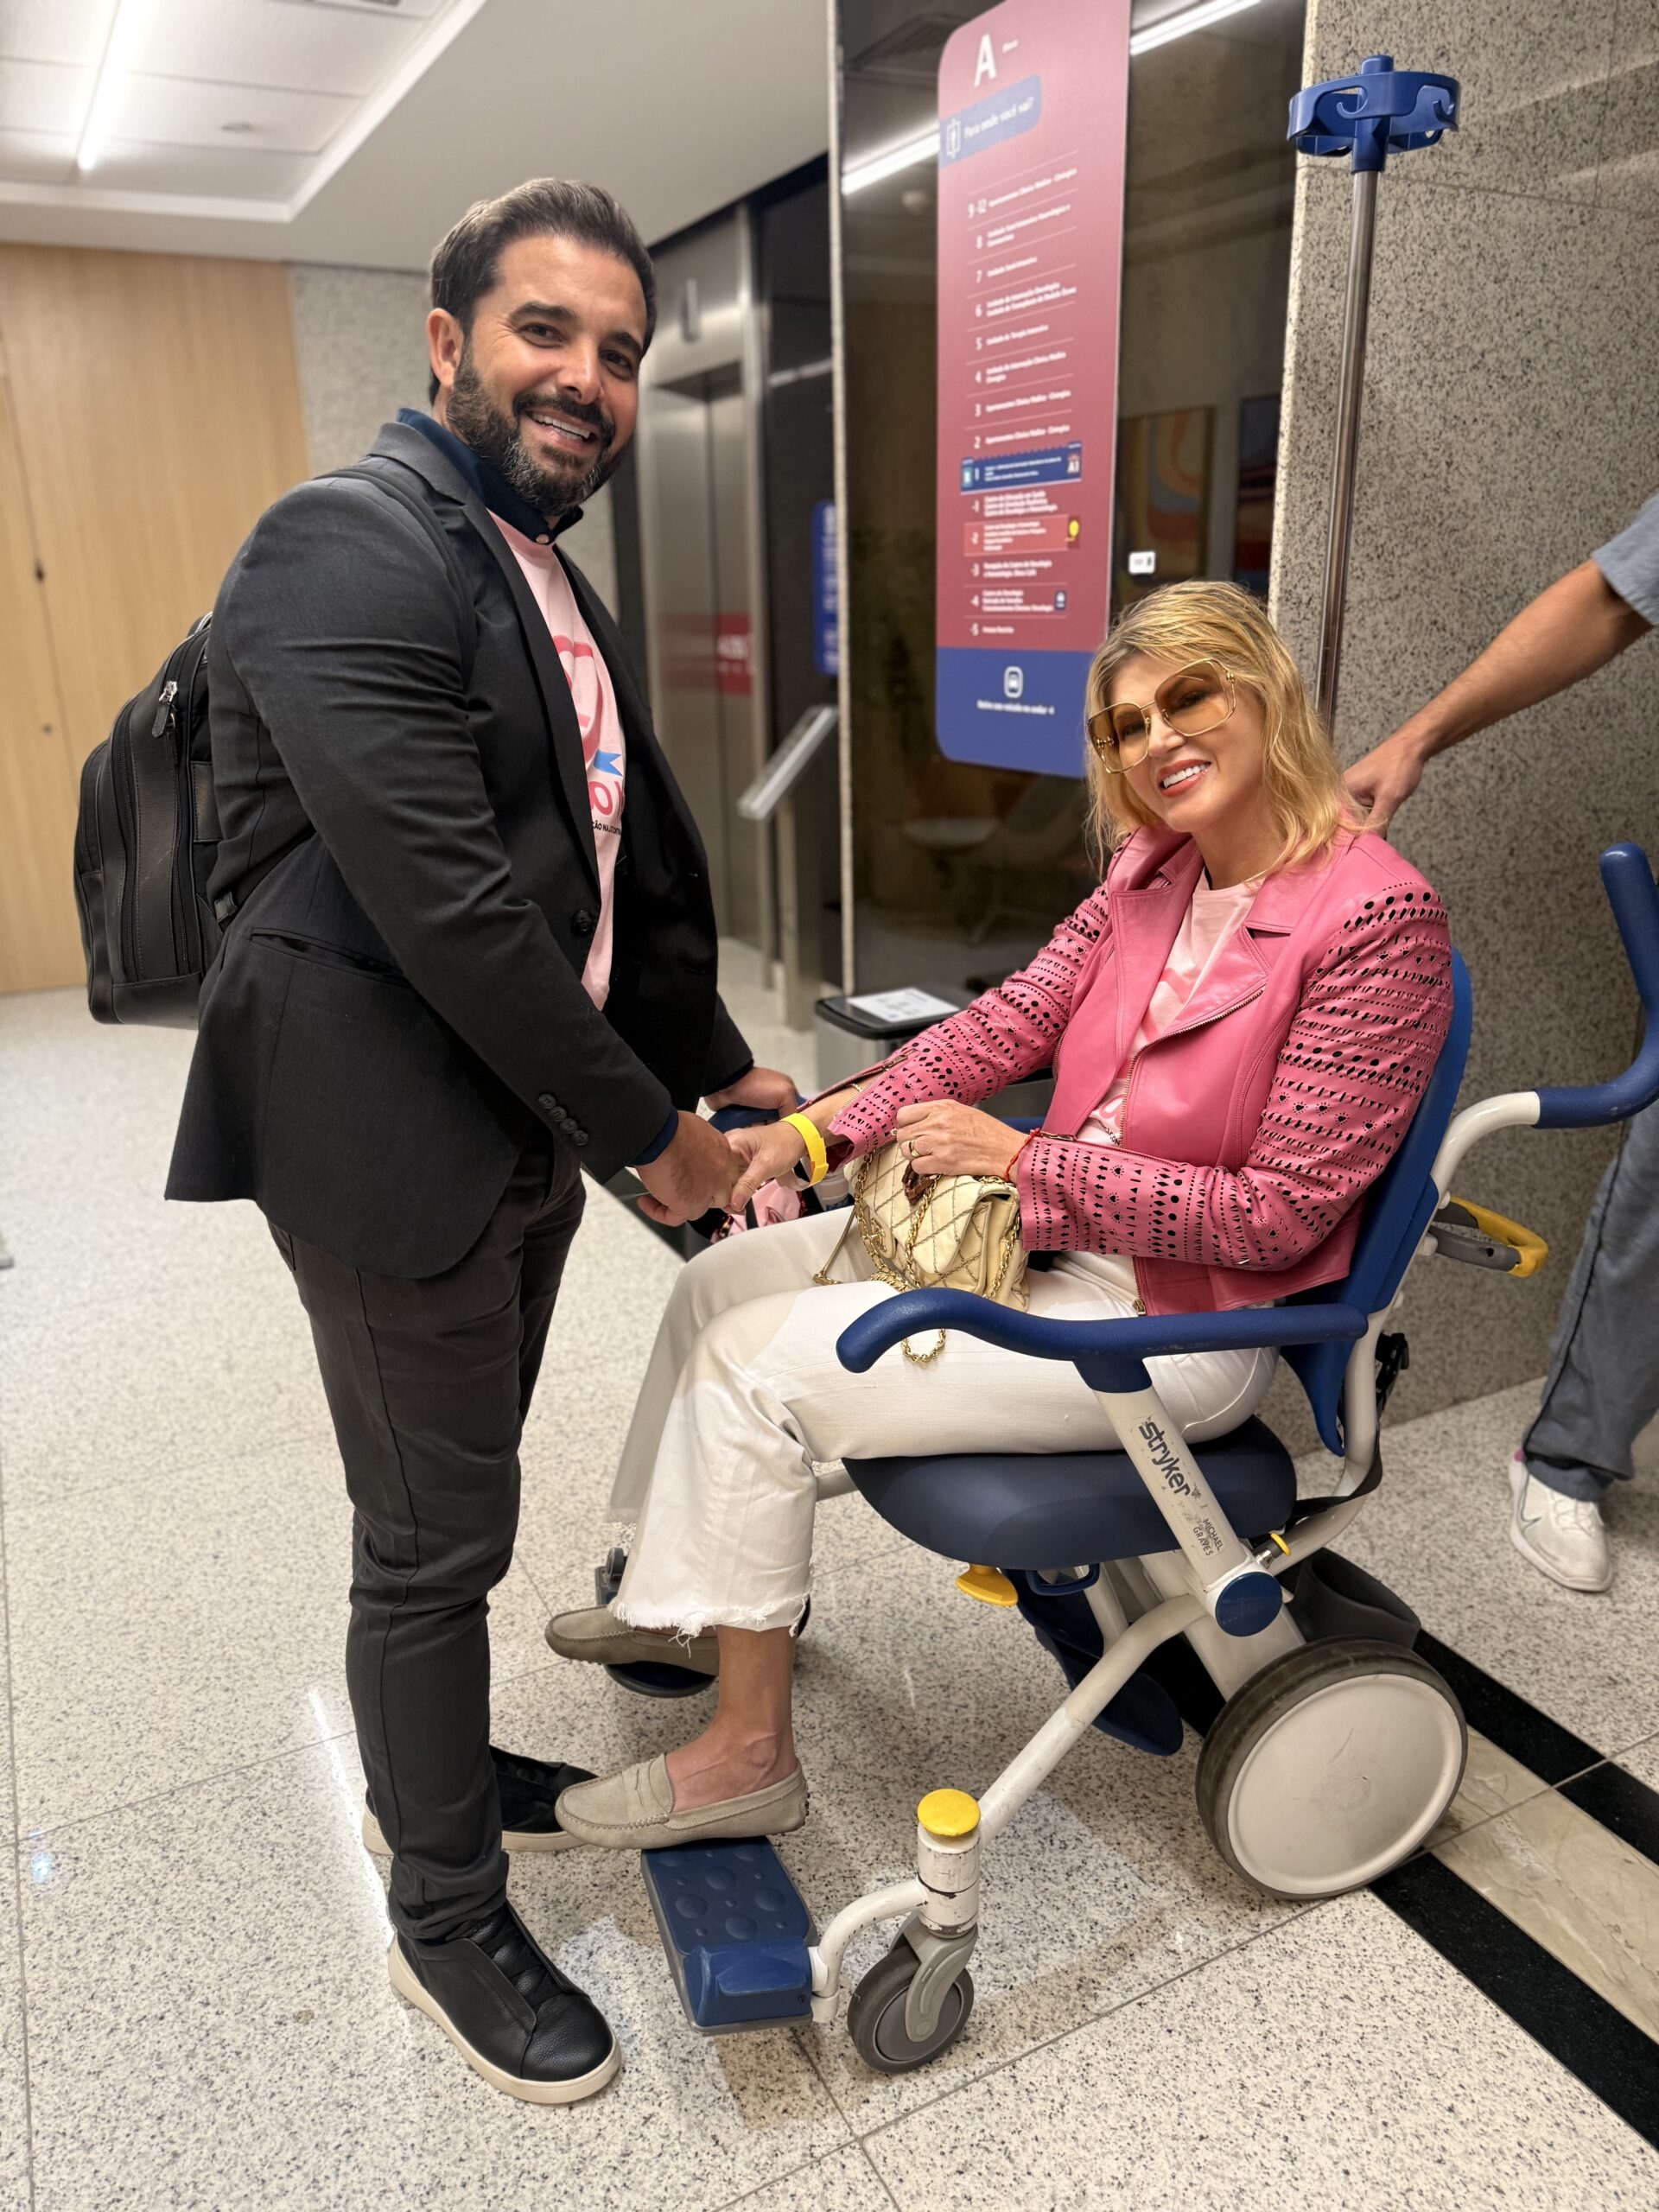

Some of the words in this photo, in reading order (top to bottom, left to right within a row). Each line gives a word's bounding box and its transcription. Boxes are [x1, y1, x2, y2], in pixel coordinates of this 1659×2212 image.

[974, 34, 996, 87] A
[976, 337, 982, 351] 5
[975, 371, 982, 384] 4
[975, 404, 982, 417] 3
[974, 435, 982, 449] 2
[1139, 1421, 1191, 1497] stryker
[1193, 1527, 1214, 1556] GRAVES
[1203, 1518, 1224, 1552] MICHAEL
